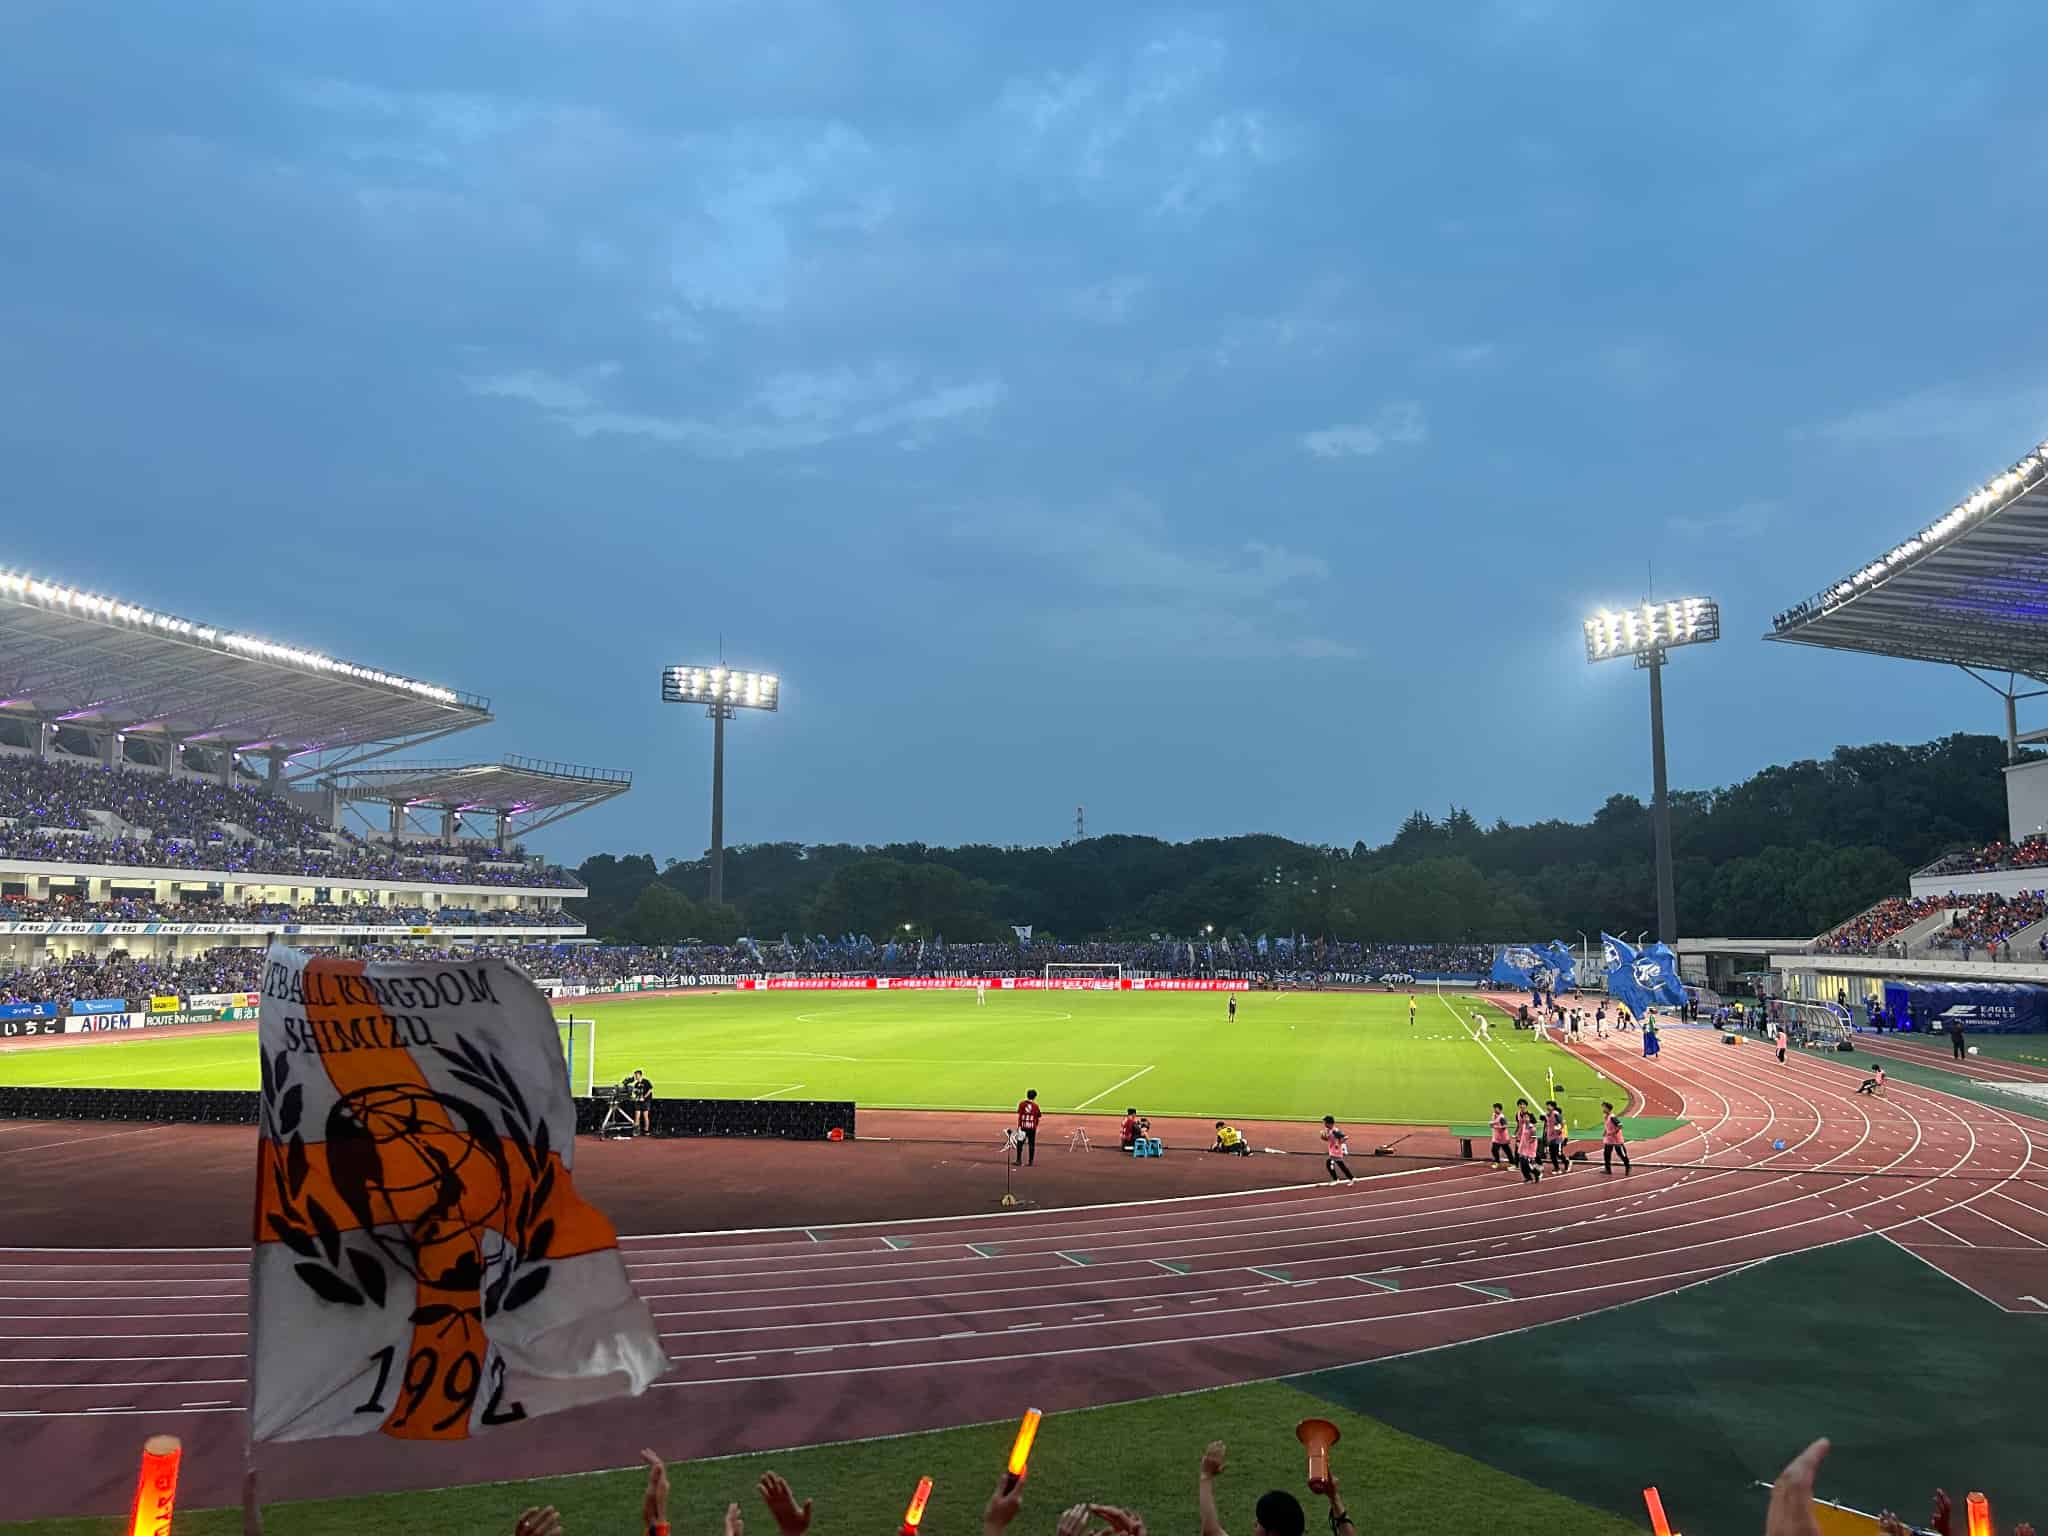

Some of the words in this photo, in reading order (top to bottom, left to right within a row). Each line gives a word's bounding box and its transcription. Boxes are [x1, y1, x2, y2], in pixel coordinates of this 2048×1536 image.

[333, 968, 502, 1009] KINGDOM
[680, 975, 697, 986] NO
[4, 1019, 57, 1036] いちご
[146, 1015, 174, 1025] ROUTE
[284, 1014, 440, 1054] SHIMIZU
[353, 1344, 528, 1432] 1992
